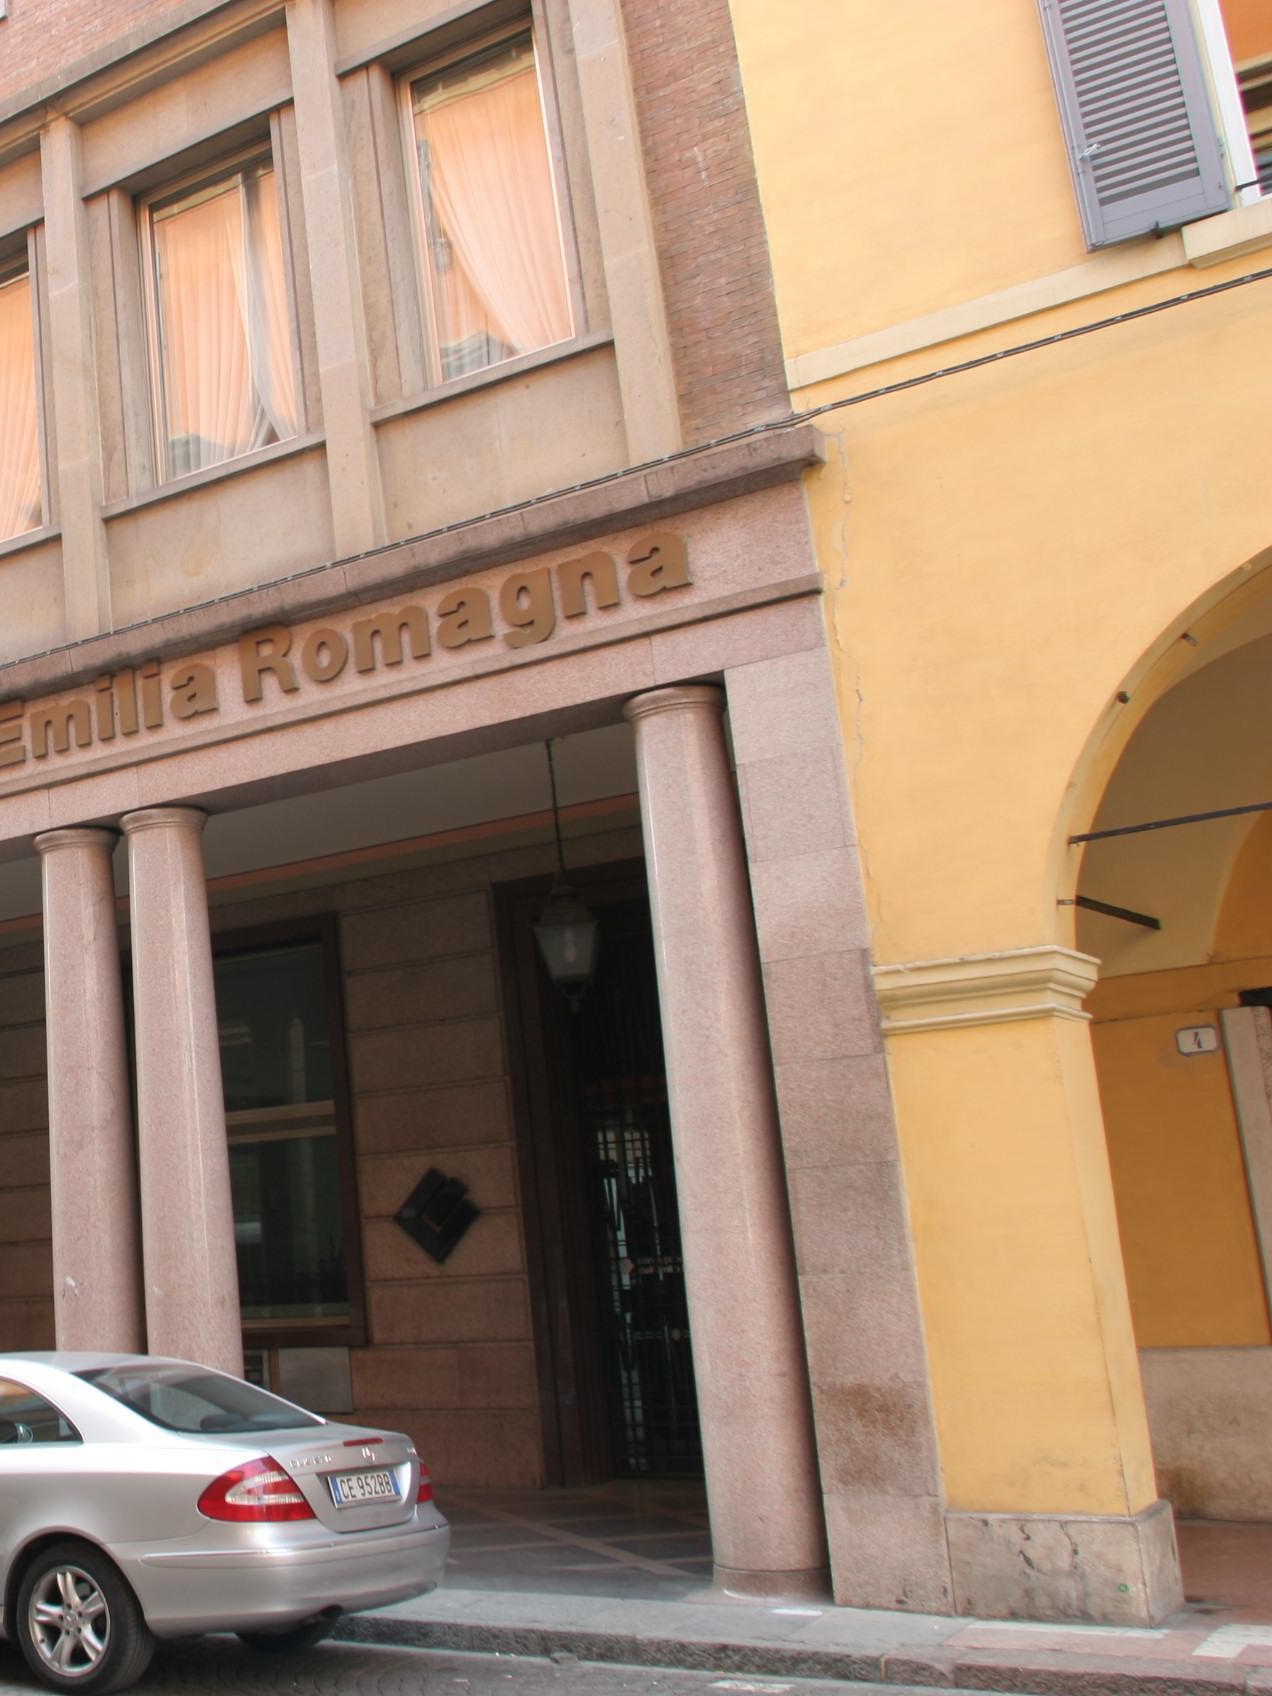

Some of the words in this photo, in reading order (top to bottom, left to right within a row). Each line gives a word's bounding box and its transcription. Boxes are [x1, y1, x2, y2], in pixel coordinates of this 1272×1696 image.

[237, 531, 693, 703] Romagna
[340, 1478, 356, 1499] CE
[357, 1473, 392, 1497] 952BB
